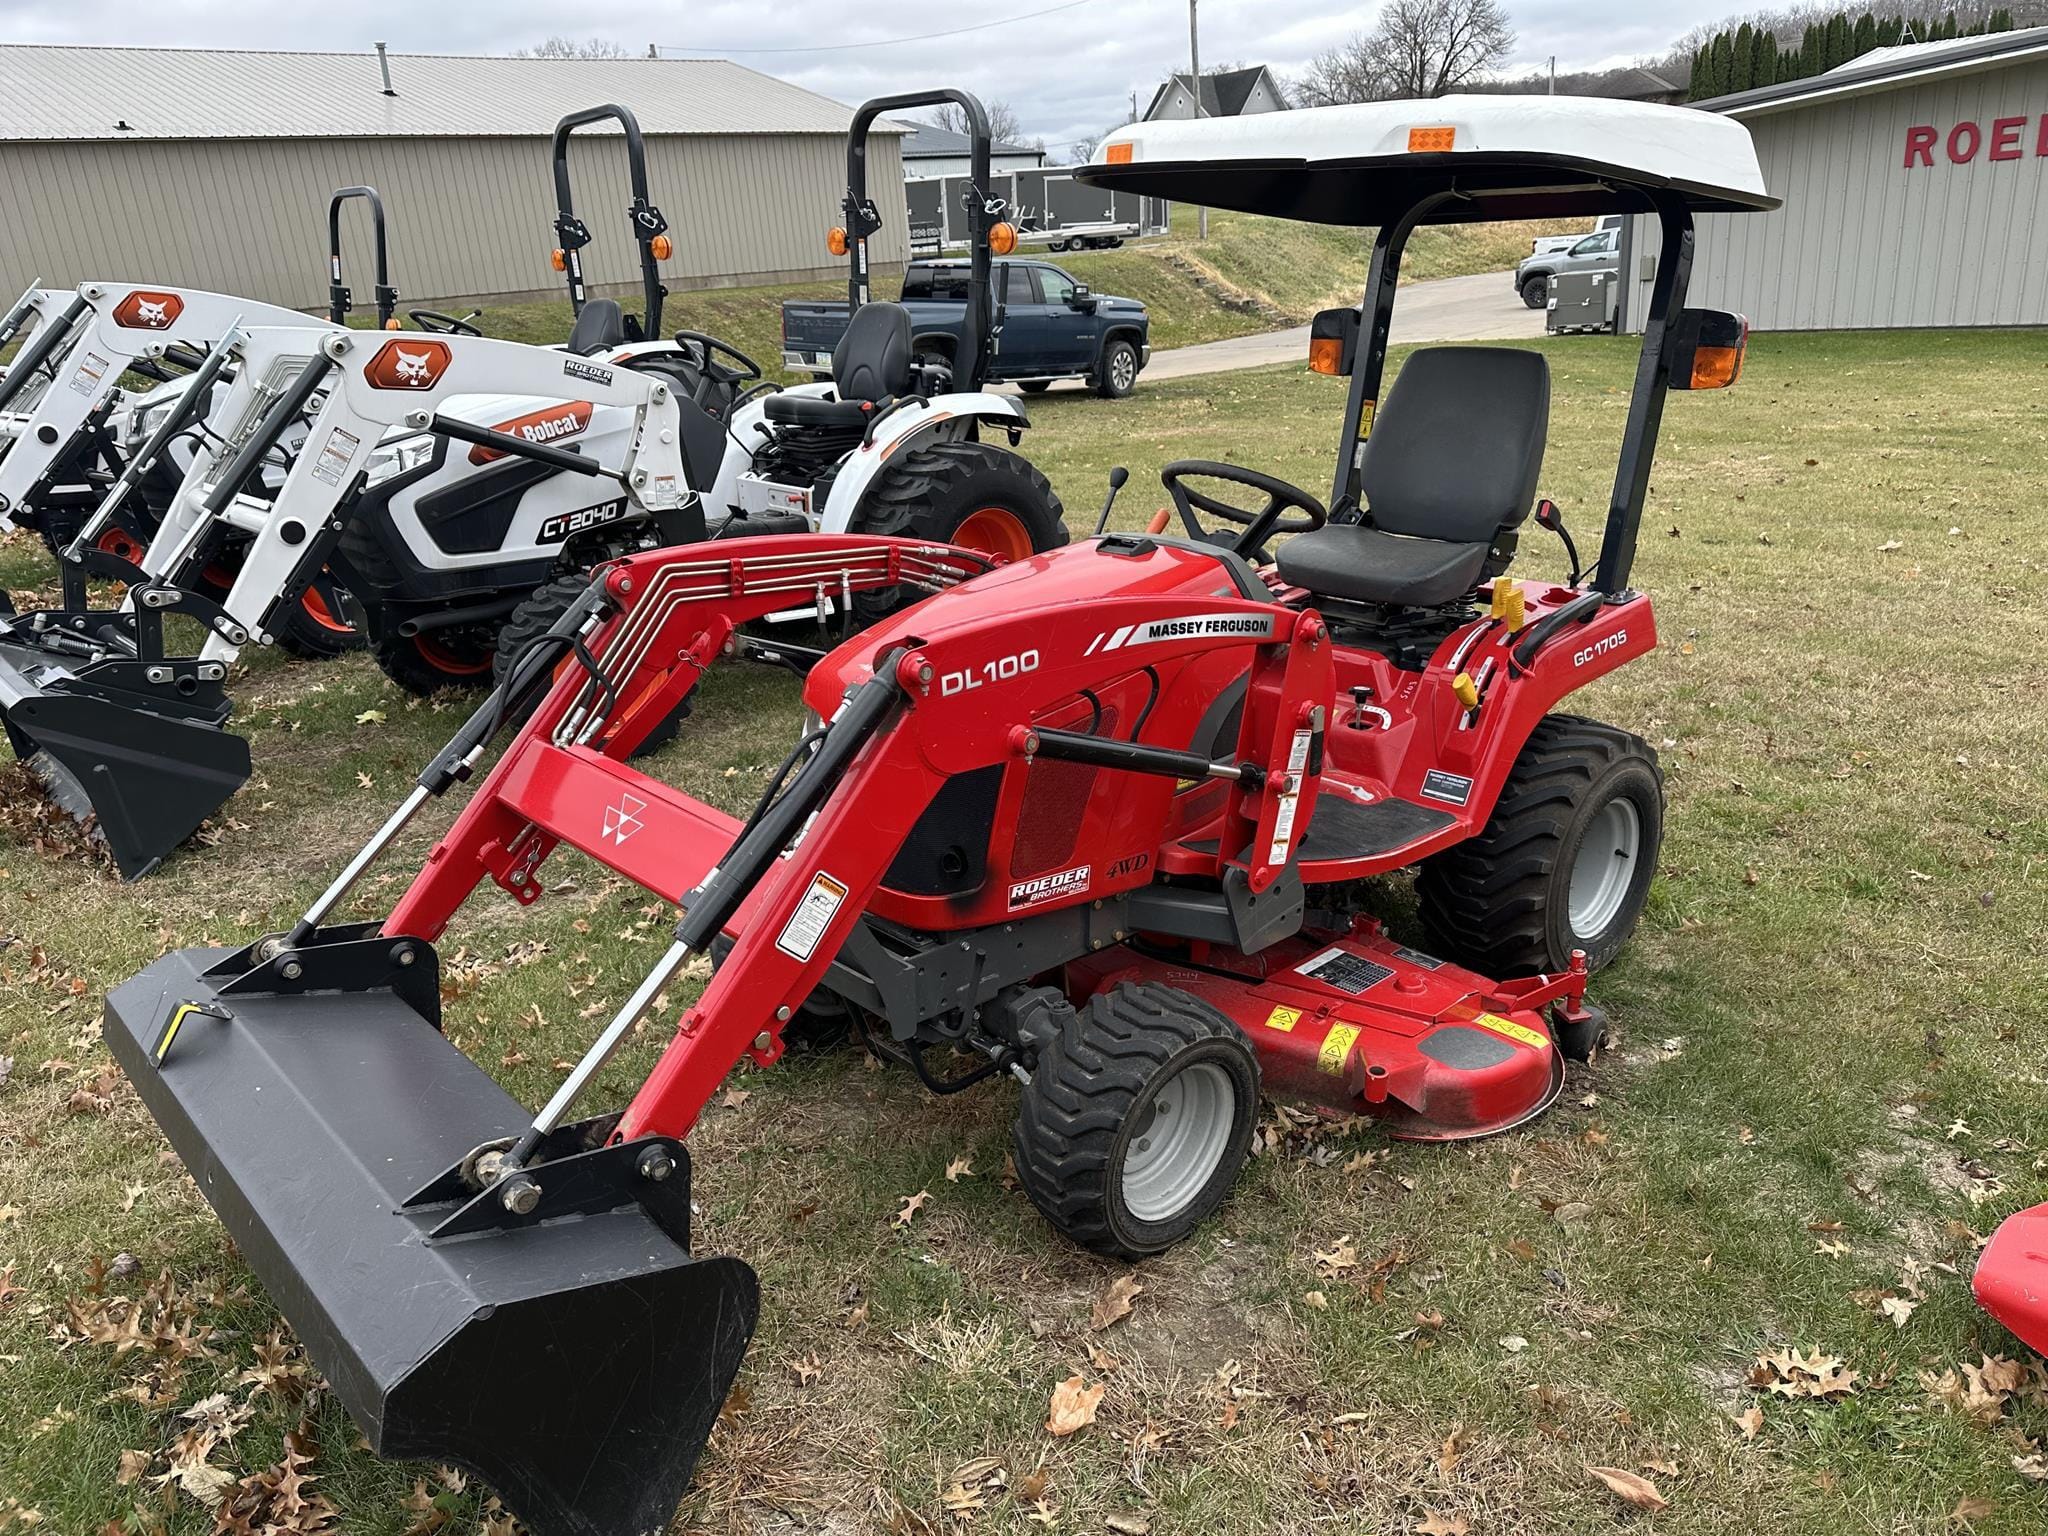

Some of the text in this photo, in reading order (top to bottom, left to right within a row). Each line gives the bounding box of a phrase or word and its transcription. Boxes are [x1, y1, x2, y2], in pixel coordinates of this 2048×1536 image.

[1903, 113, 2048, 168] ROE
[566, 361, 612, 379] ROEDER
[521, 412, 580, 442] Bobcat
[543, 502, 617, 538] CT2040
[1149, 619, 1268, 638] MASSEY FERGUSON
[1573, 629, 1627, 667] GC1705
[941, 649, 1039, 697] DL100
[1106, 853, 1149, 878] 4WD
[1010, 867, 1089, 898] ROEDER
[1030, 880, 1083, 901] BROTHERS
